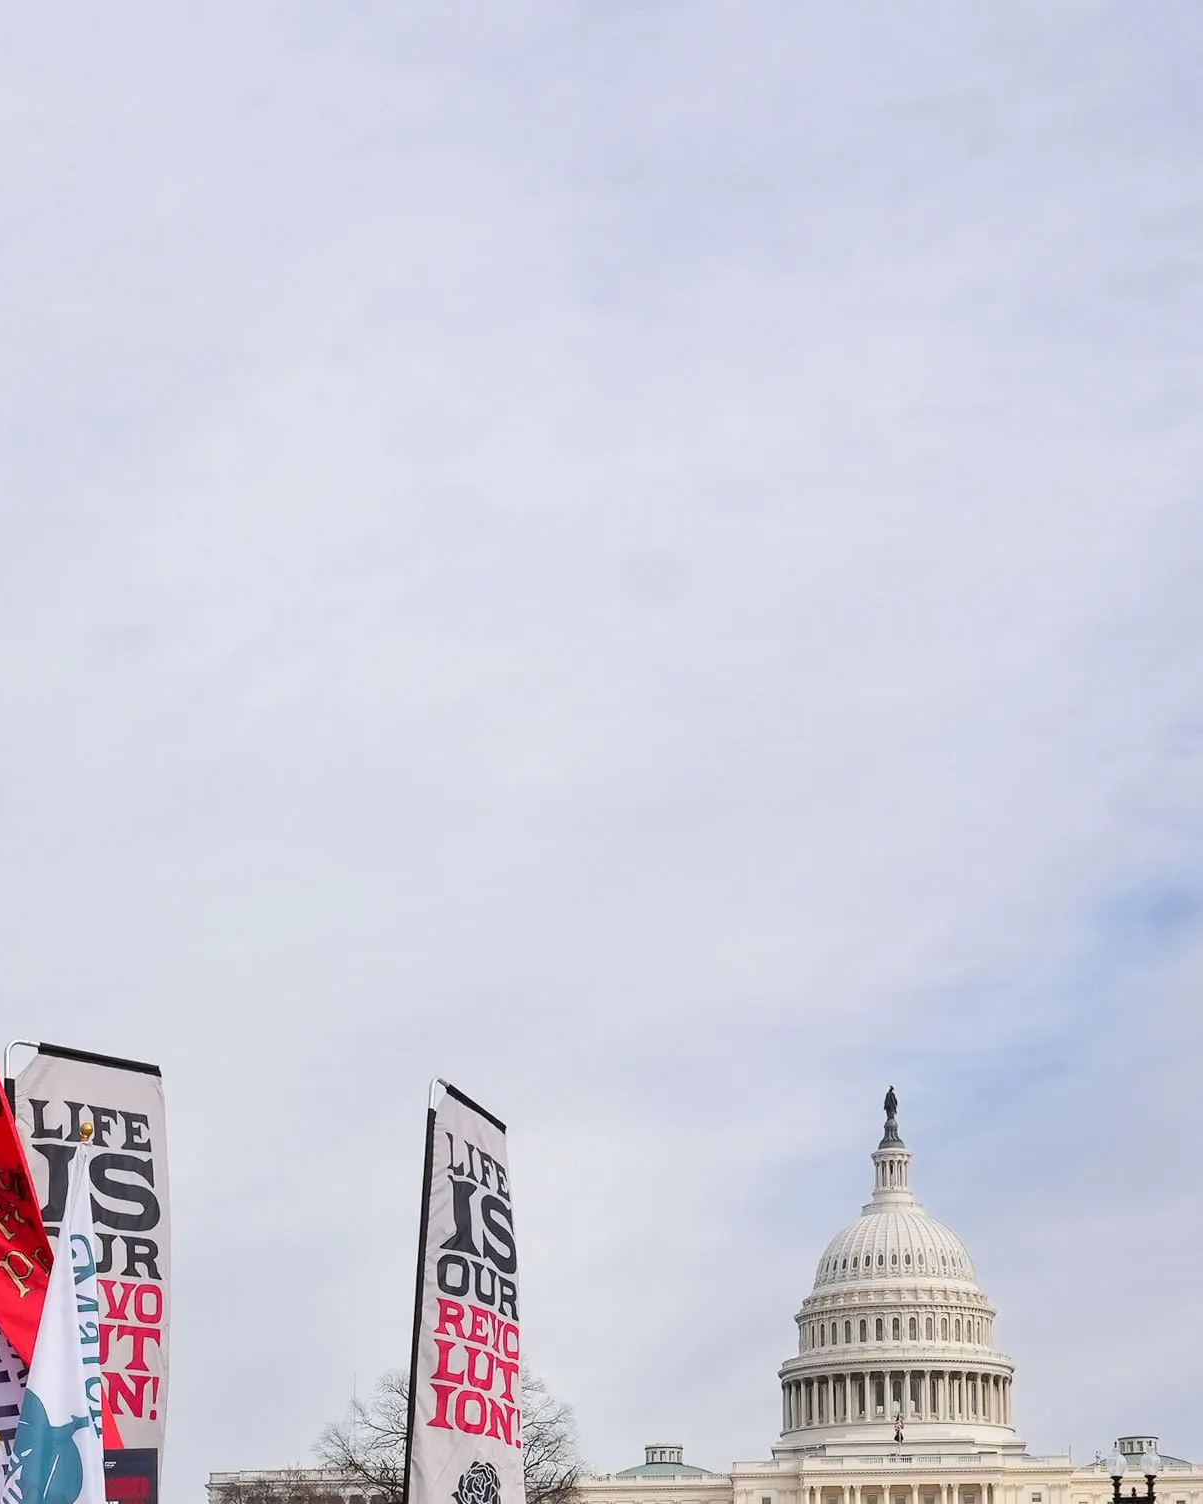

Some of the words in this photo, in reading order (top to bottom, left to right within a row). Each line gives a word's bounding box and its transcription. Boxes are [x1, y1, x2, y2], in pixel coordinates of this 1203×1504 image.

[28, 1098, 152, 1153] LIFE
[32, 1143, 161, 1232] IS
[446, 1131, 510, 1197] LIFE
[440, 1174, 518, 1275] IS
[436, 1253, 519, 1322] OUR
[430, 1338, 520, 1403] LUT
[426, 1382, 522, 1449] ION!
